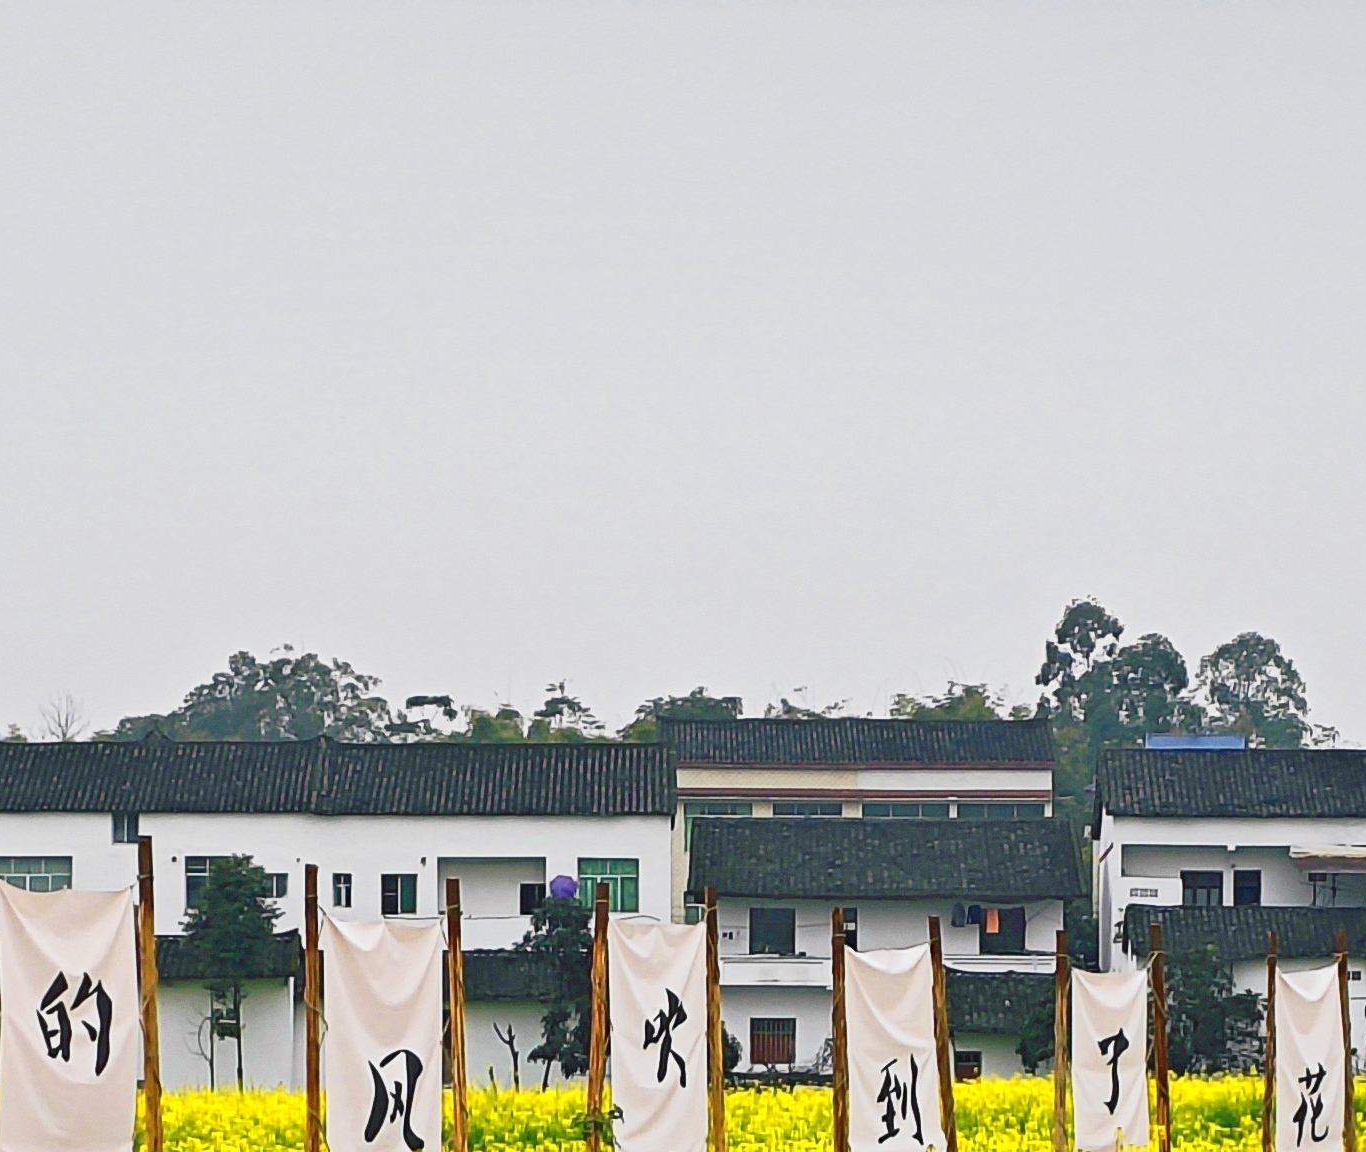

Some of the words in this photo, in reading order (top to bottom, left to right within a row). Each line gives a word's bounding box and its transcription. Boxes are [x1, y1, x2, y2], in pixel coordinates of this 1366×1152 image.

[36, 971, 113, 1077] 的
[642, 988, 688, 1089] 吹
[1097, 1027, 1130, 1115] 了
[364, 1049, 425, 1152] 风
[876, 1054, 924, 1146] 到
[1292, 1062, 1329, 1148] 花
